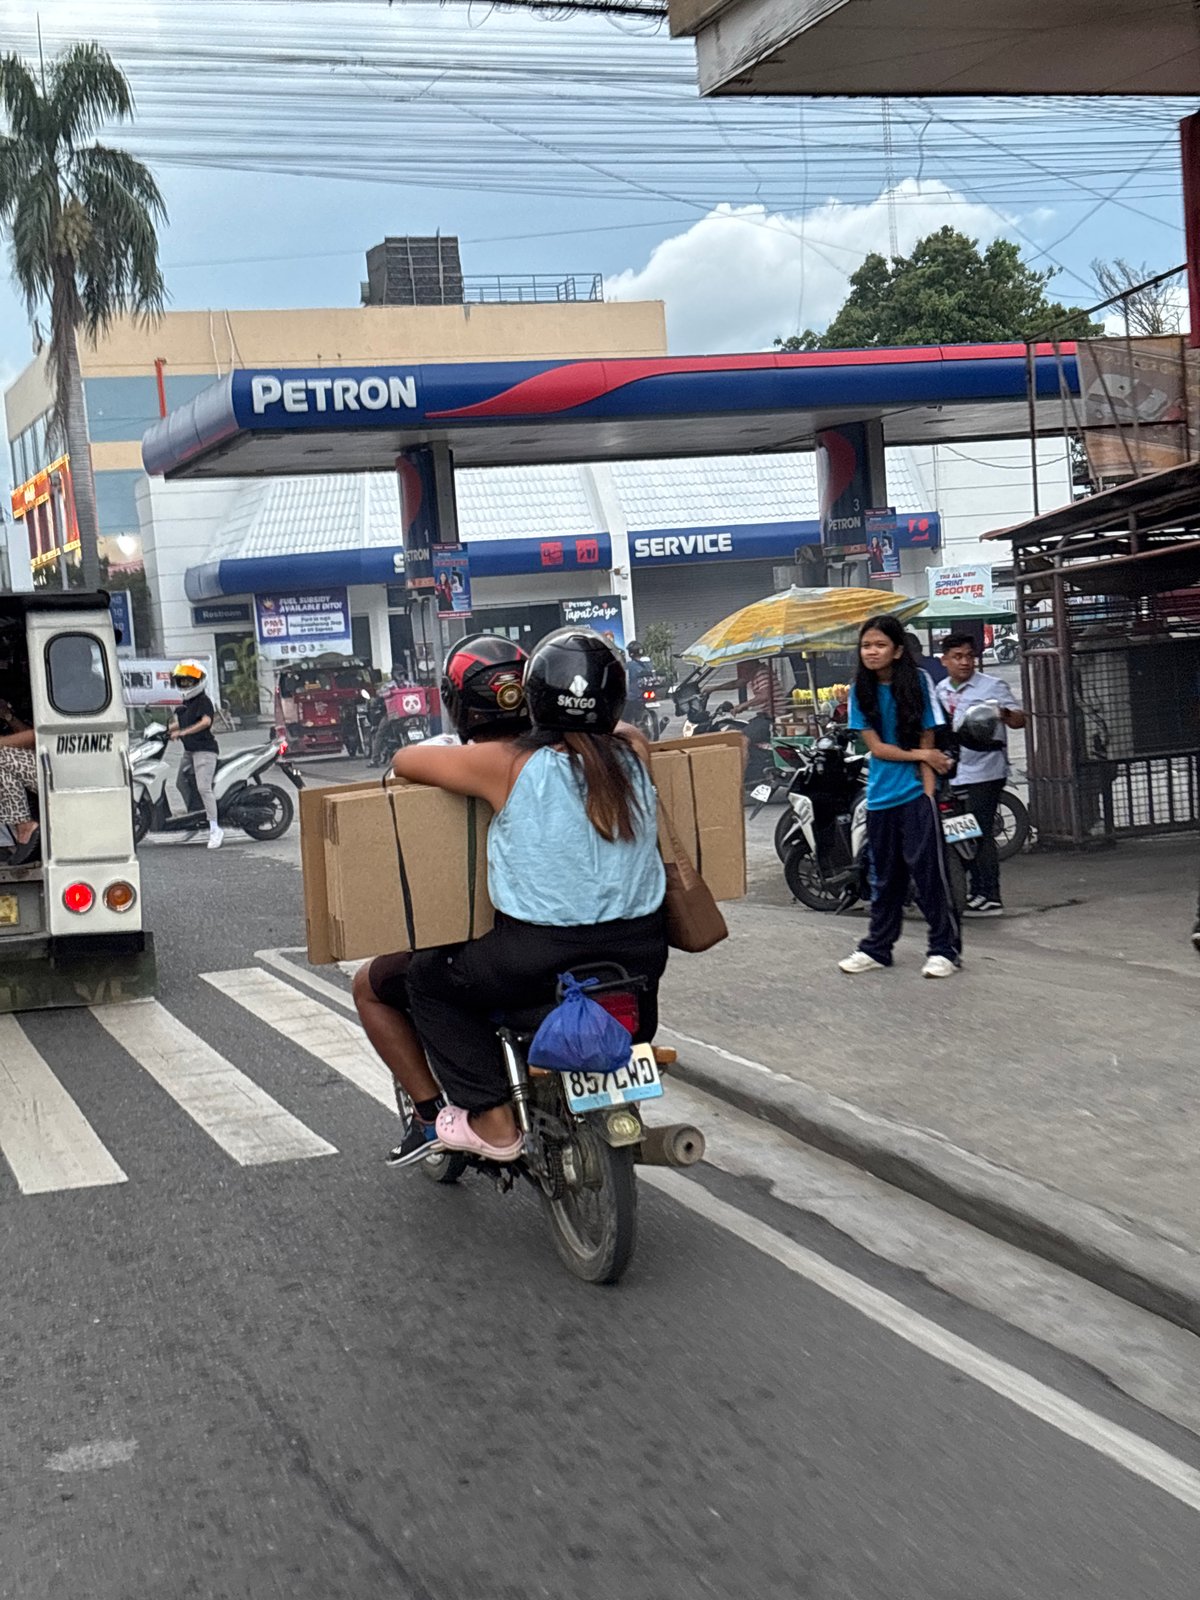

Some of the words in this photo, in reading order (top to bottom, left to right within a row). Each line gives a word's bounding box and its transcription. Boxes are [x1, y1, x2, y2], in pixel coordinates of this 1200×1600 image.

[251, 375, 417, 414] PETRON
[853, 498, 860, 512] 3
[828, 516, 861, 531] PETRON
[635, 533, 733, 558] SERVICE
[404, 549, 430, 562] ETRON
[935, 579, 964, 588] SPRINT
[935, 584, 984, 596] SCOOTER
[279, 603, 320, 613] AVAILABLE
[563, 607, 592, 622] Tapat
[592, 606, 618, 620] Sayo
[557, 694, 596, 709] SKYGO
[56, 733, 113, 755] DISTANCE
